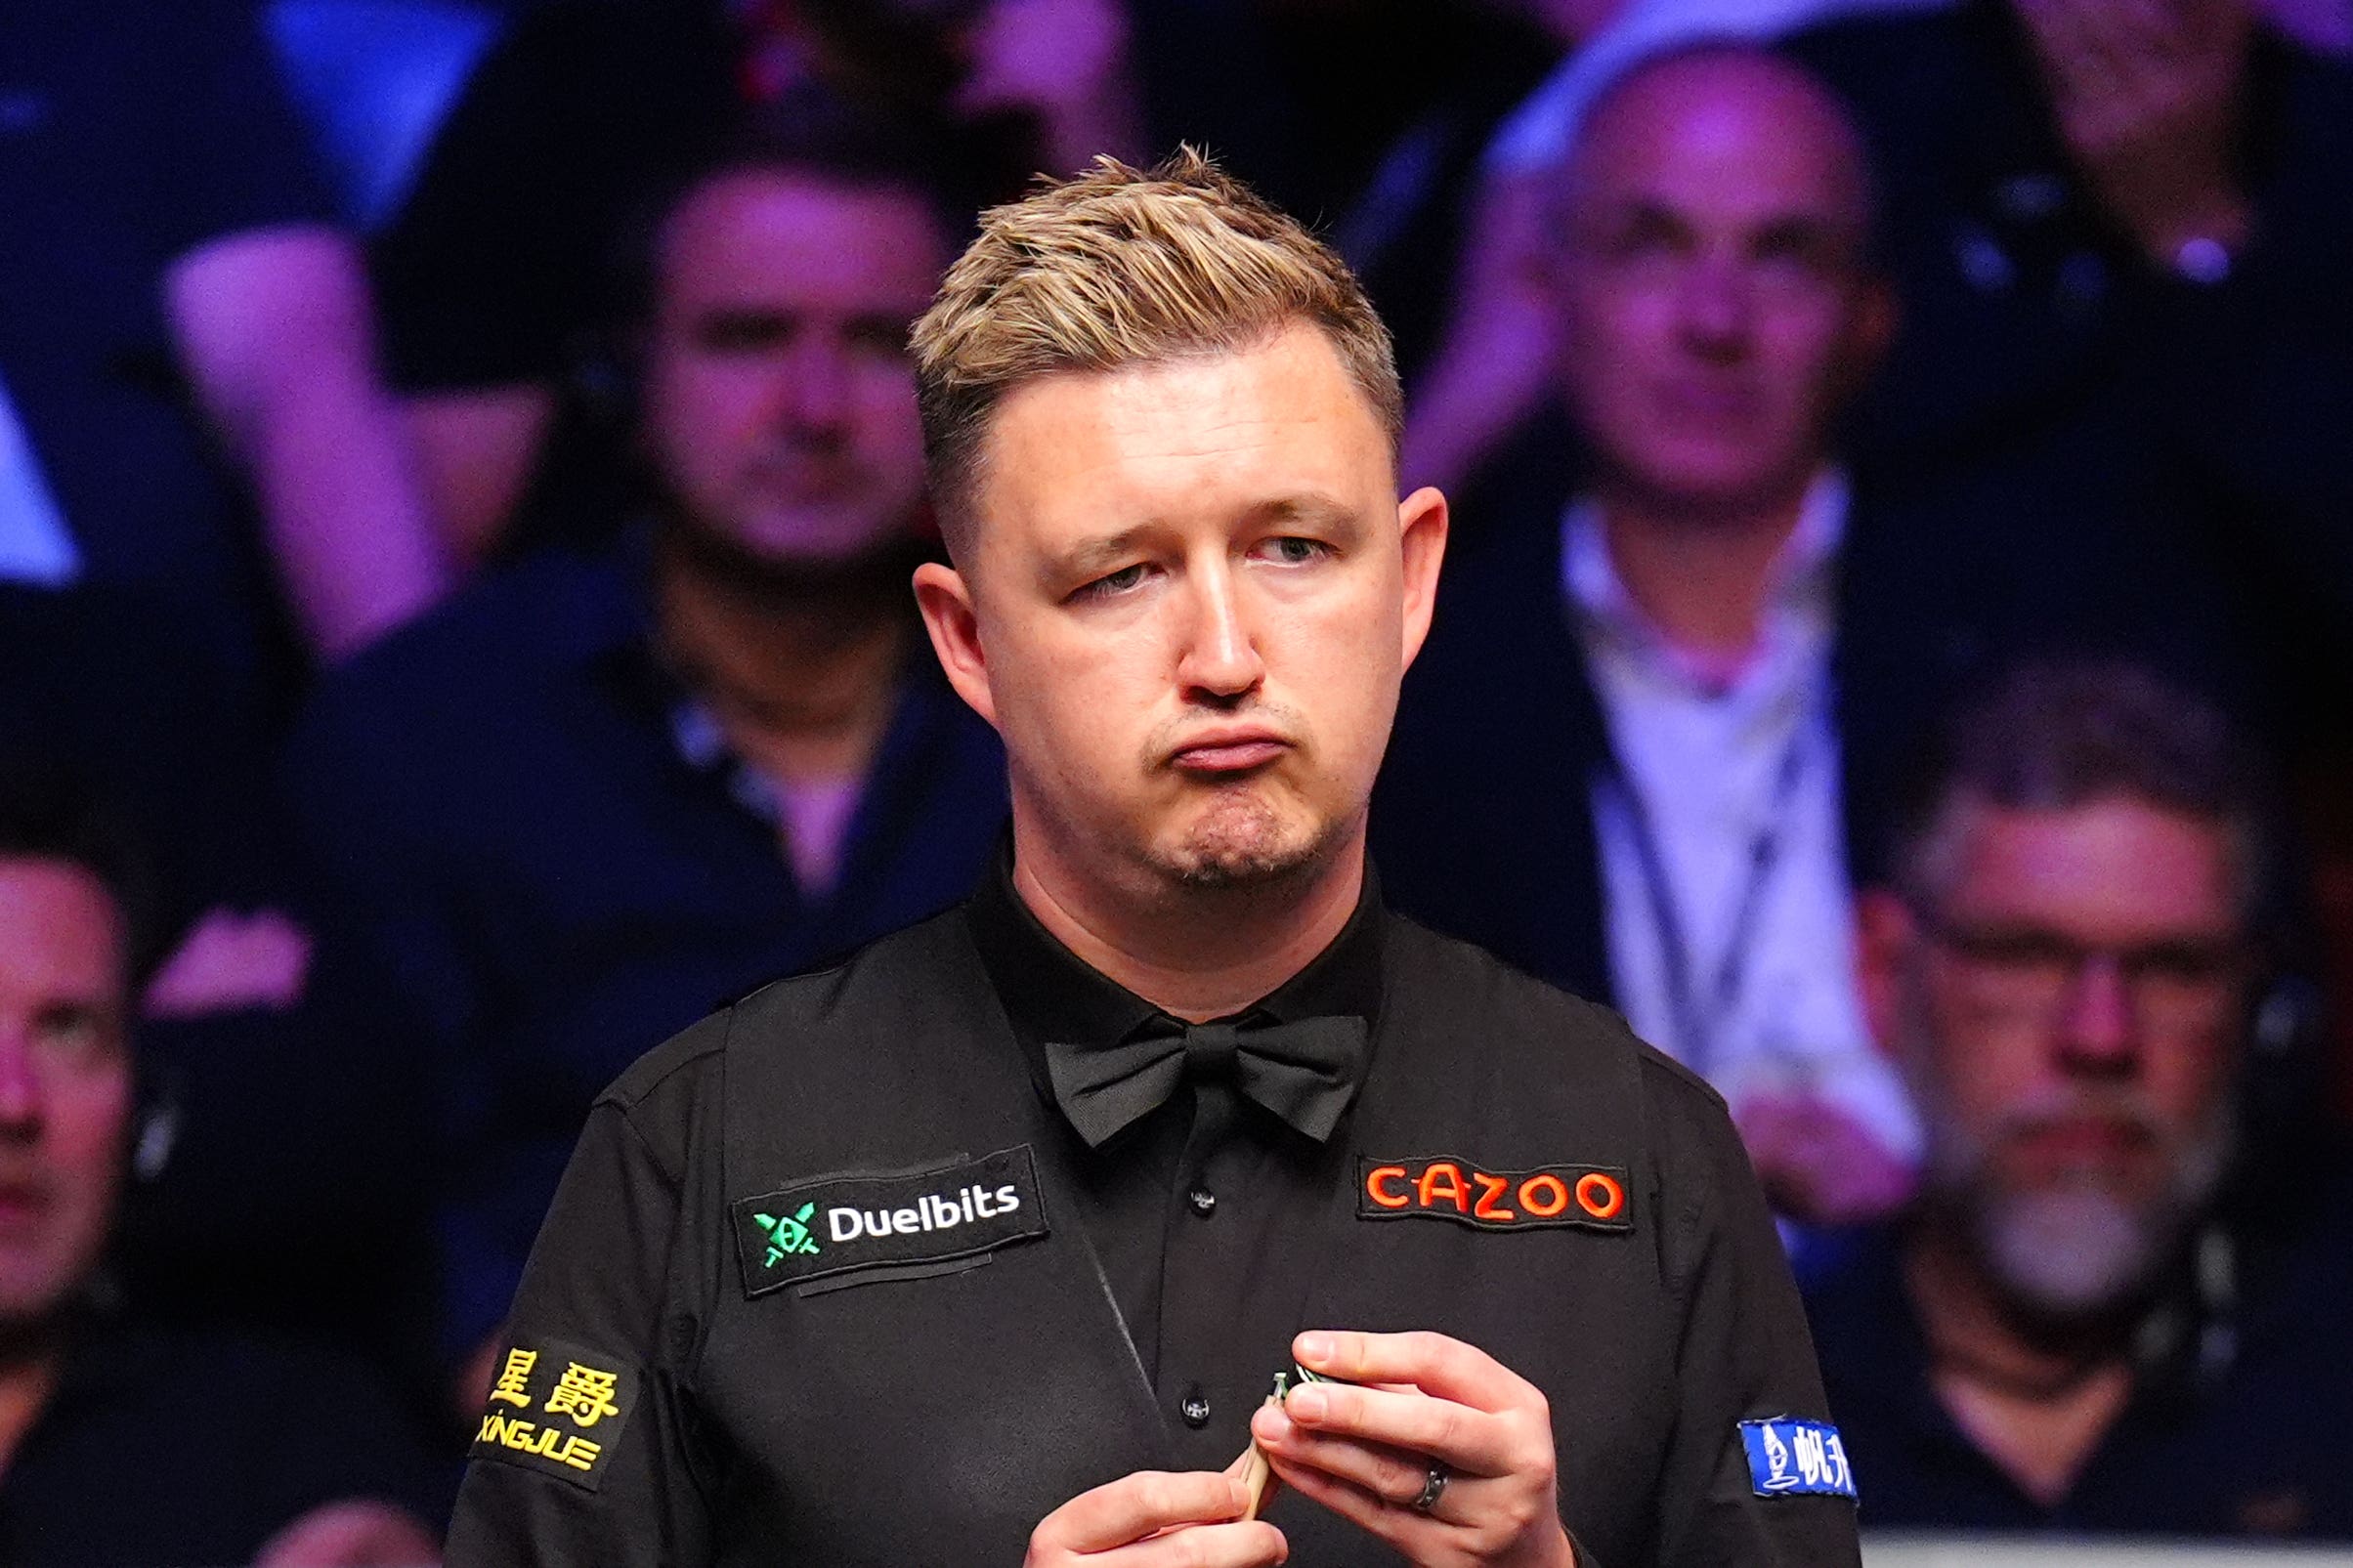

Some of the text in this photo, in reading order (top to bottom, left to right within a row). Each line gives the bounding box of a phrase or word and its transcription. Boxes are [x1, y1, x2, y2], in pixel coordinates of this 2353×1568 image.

[828, 1184, 1020, 1242] Duelbits
[1367, 1163, 1624, 1219] CAZOO
[490, 1347, 619, 1427] 星爵
